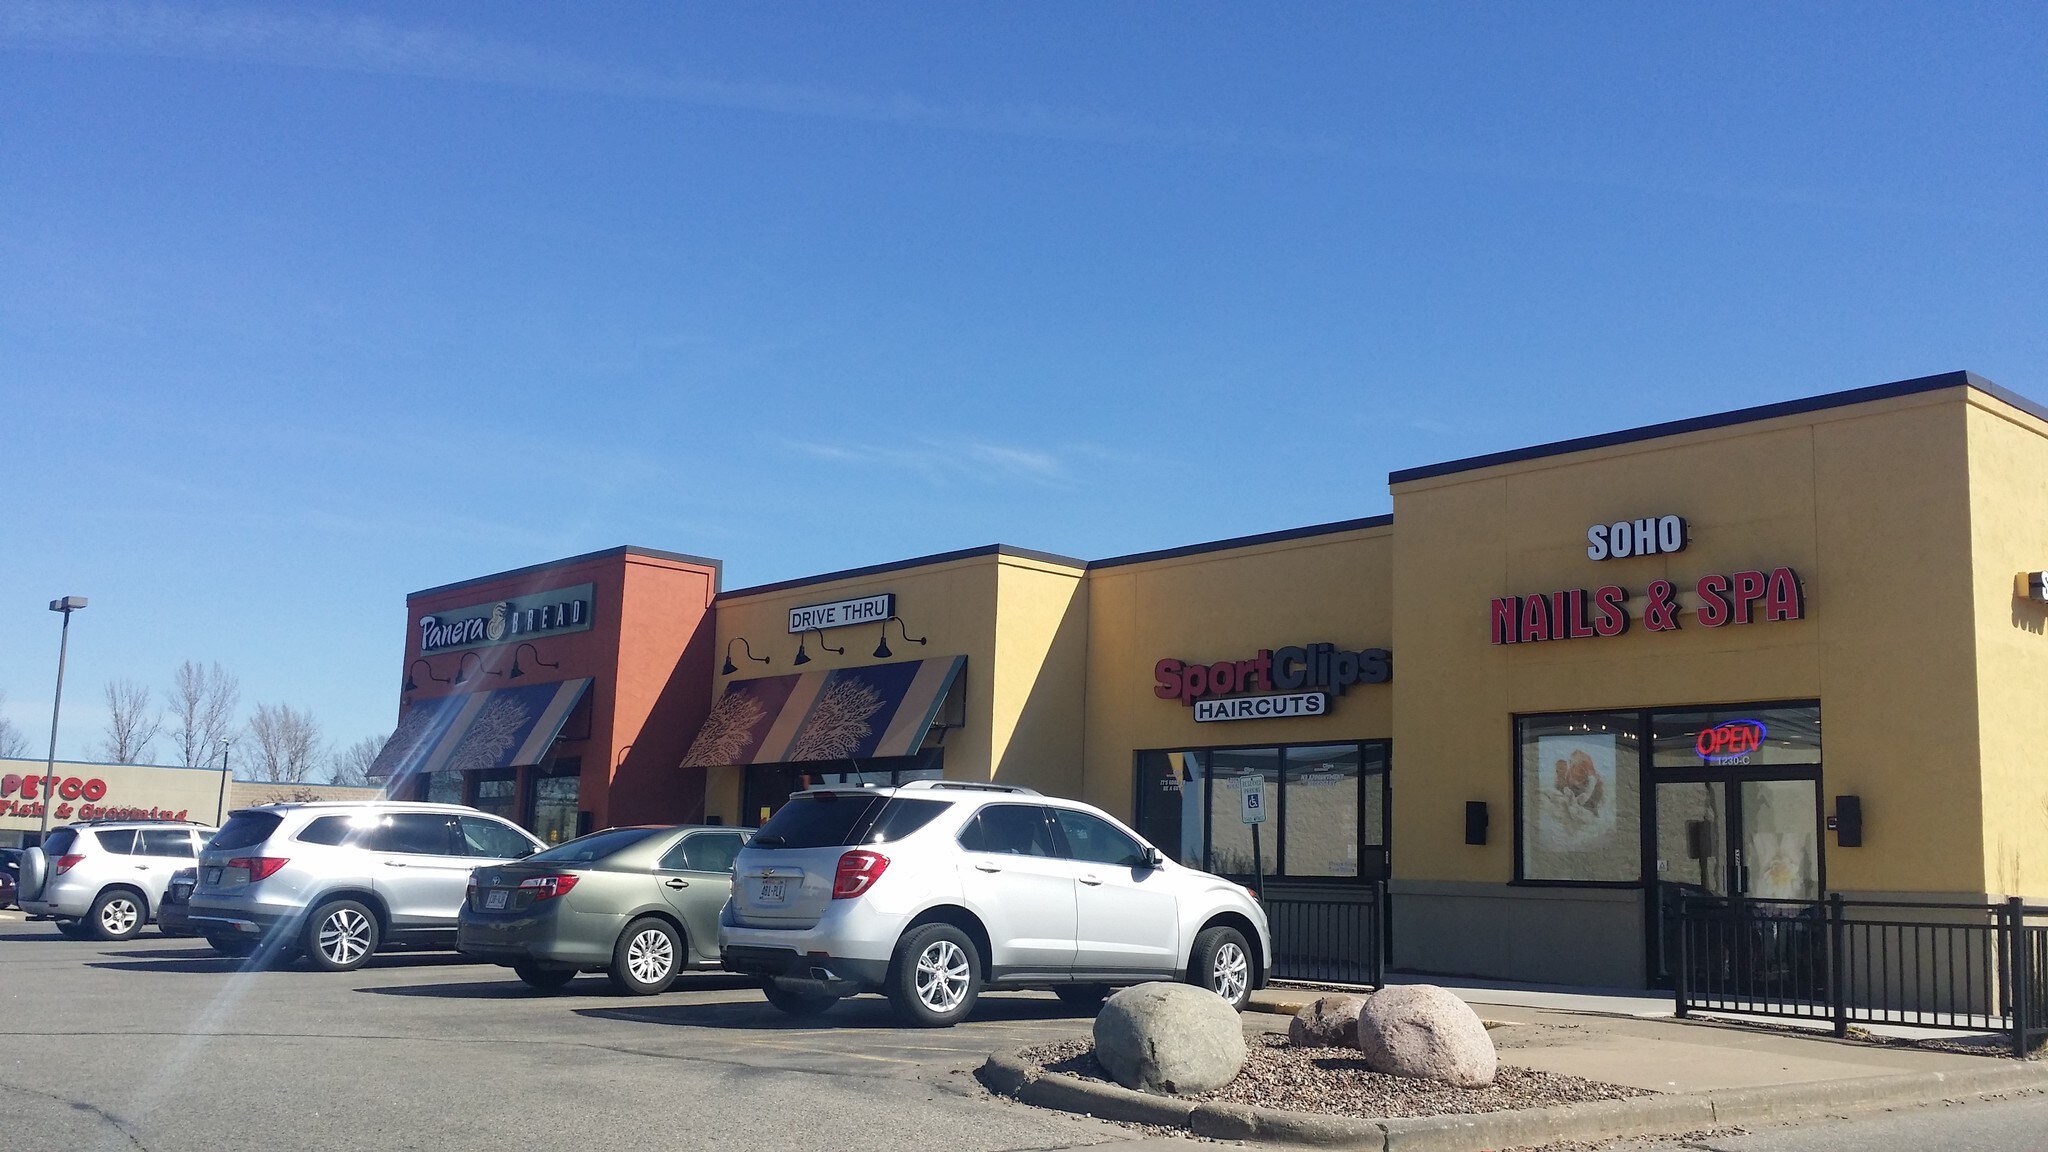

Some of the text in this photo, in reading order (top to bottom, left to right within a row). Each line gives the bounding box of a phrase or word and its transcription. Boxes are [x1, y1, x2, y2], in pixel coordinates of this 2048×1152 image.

[1587, 514, 1685, 561] SOHO
[791, 599, 885, 629] DRIVE THRU
[1490, 566, 1802, 645] NAILS & SPA
[419, 599, 585, 650] Panera BREAD
[1198, 695, 1320, 719] HAIRCUTS
[1697, 725, 1760, 755] OPEN
[1718, 755, 1750, 766] 1230-C
[1, 774, 107, 802] PETCO
[54, 803, 74, 820] &
[78, 803, 188, 822] Grooming
